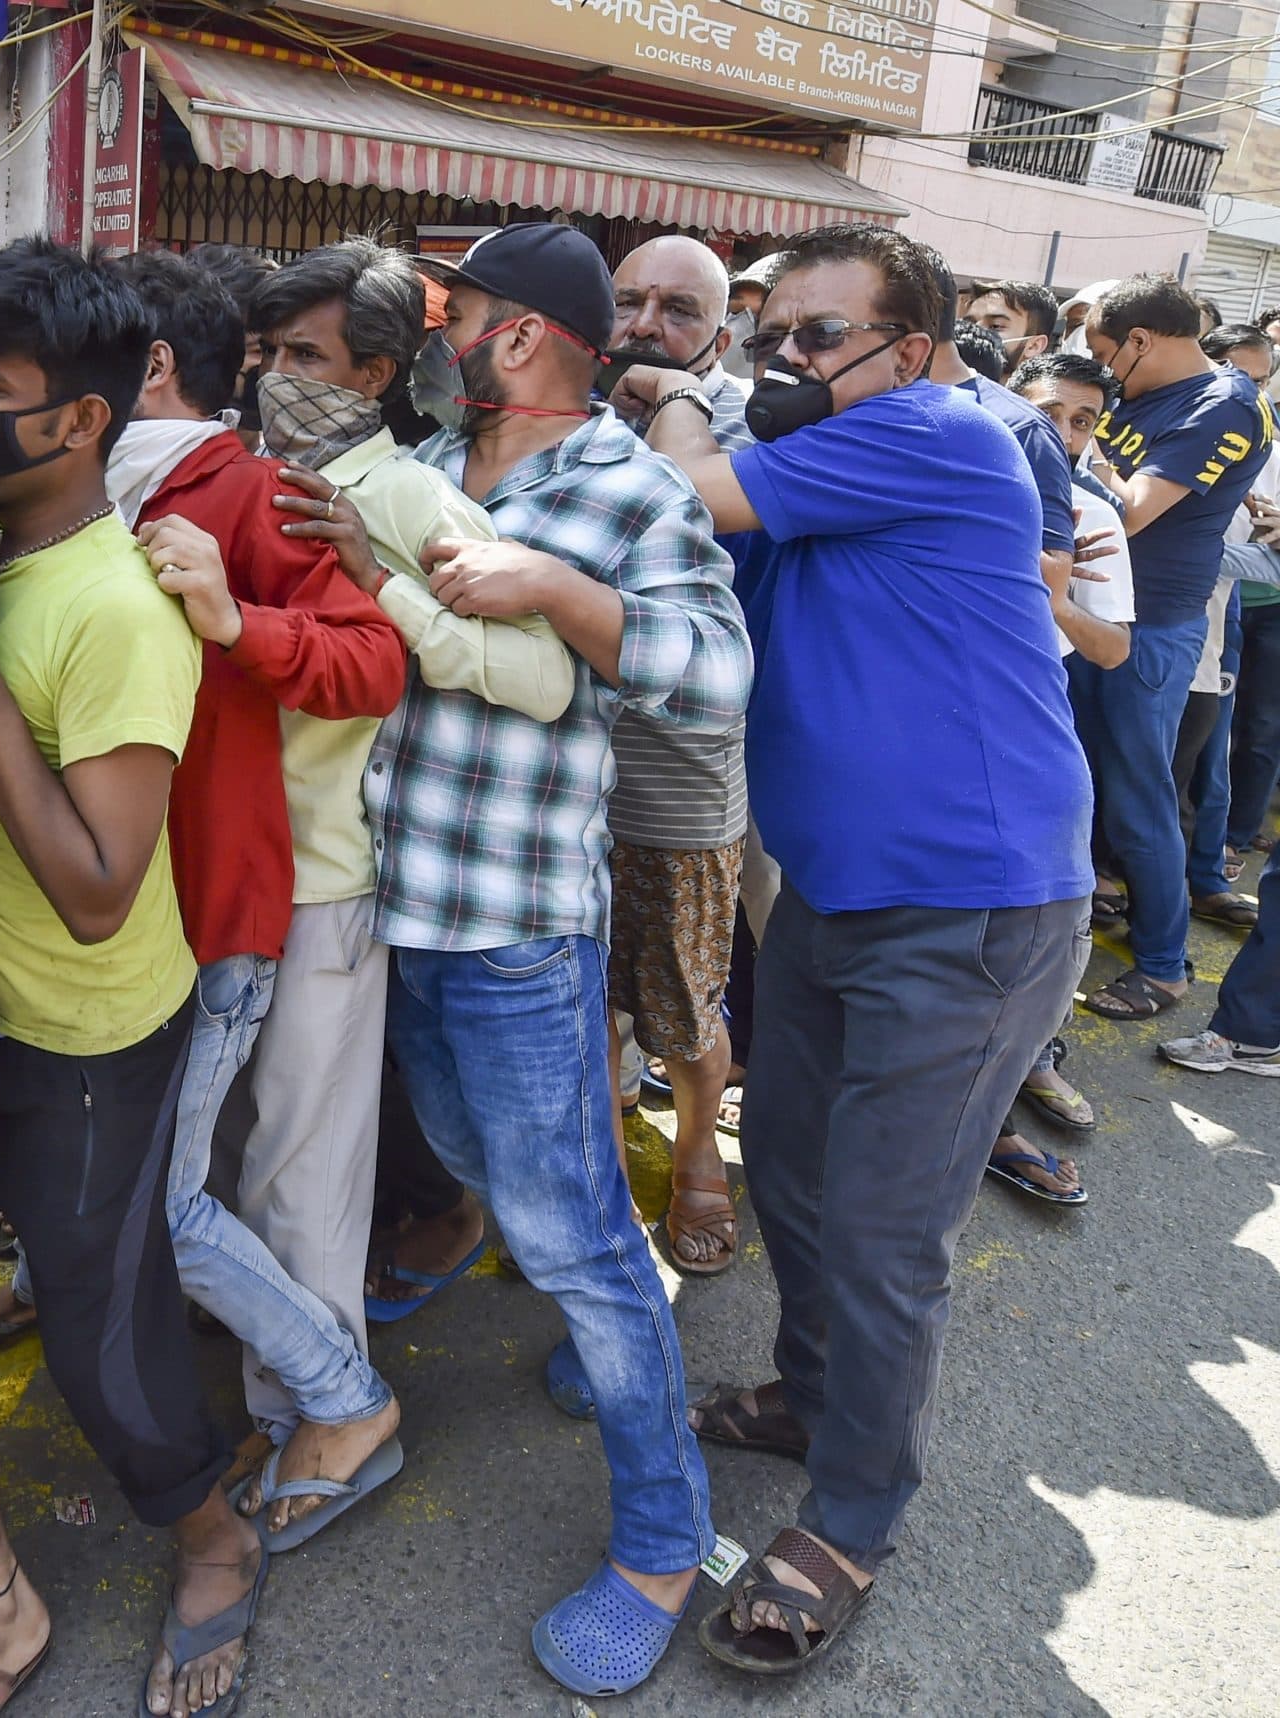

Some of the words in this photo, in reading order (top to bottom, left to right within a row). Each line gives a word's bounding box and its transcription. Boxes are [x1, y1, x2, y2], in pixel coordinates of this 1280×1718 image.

[634, 42, 712, 72] LOCKERS
[715, 62, 795, 91] AVAILABLE
[798, 81, 881, 110] Branch-KRISHNA
[882, 101, 918, 119] NAGAR
[94, 164, 129, 185] MGARHIA
[102, 213, 131, 231] LIMITED
